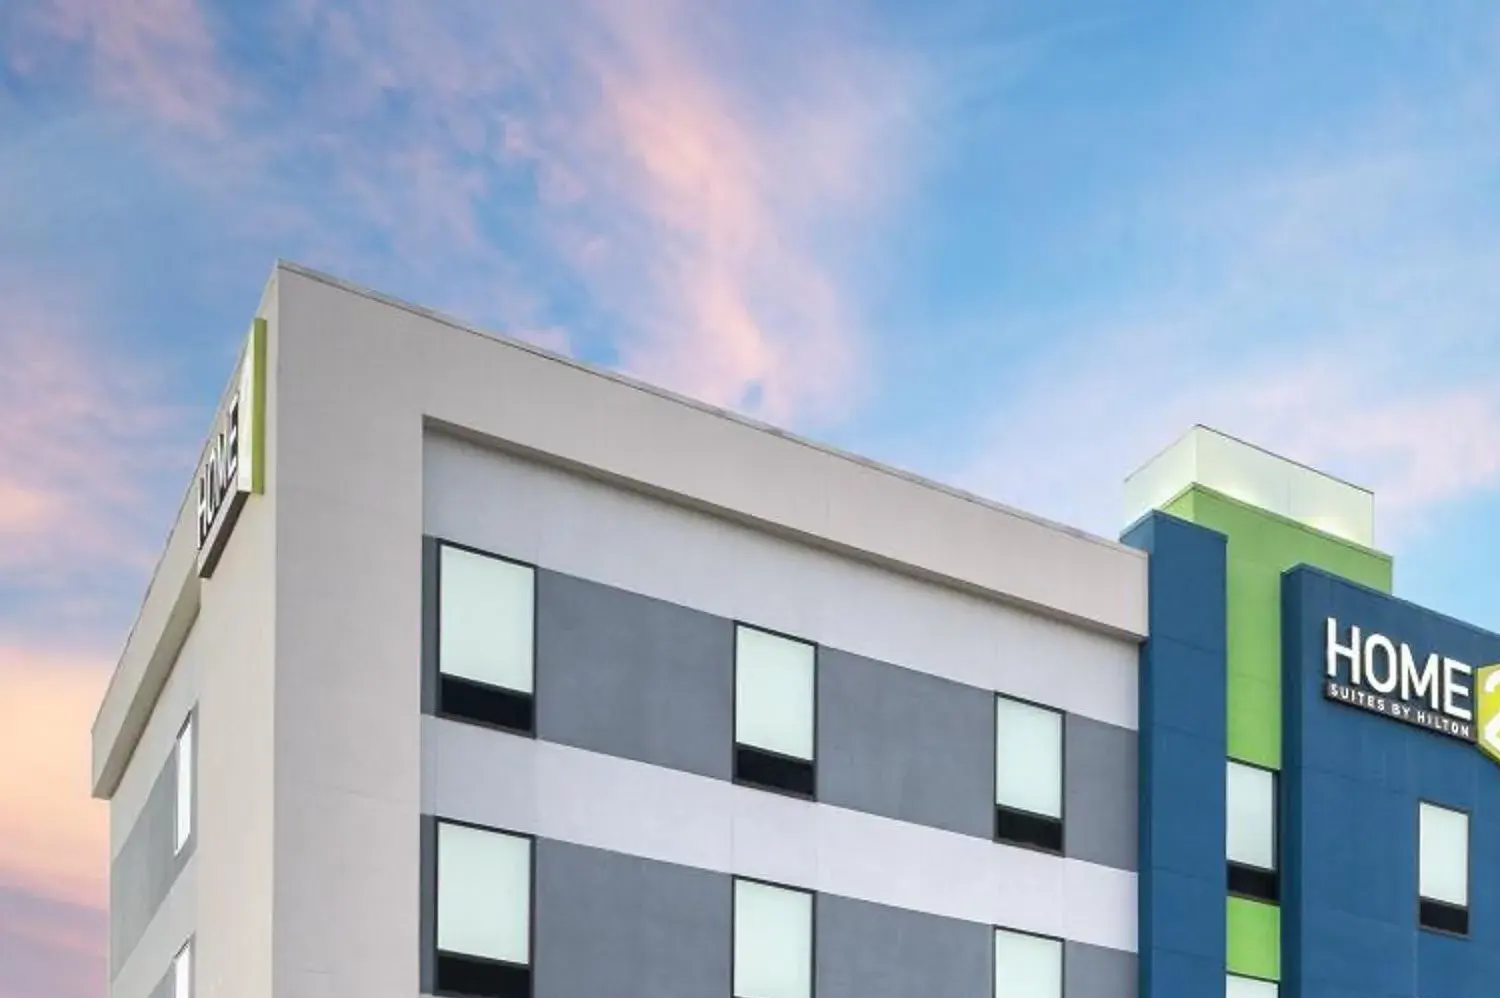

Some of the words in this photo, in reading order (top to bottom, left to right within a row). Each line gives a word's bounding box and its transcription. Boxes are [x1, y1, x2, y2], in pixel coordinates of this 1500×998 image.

[197, 392, 239, 550] HOME
[1327, 617, 1473, 721] HOME
[1330, 683, 1385, 712] SUITES
[1391, 703, 1411, 718] BY
[1417, 711, 1470, 738] HILTON
